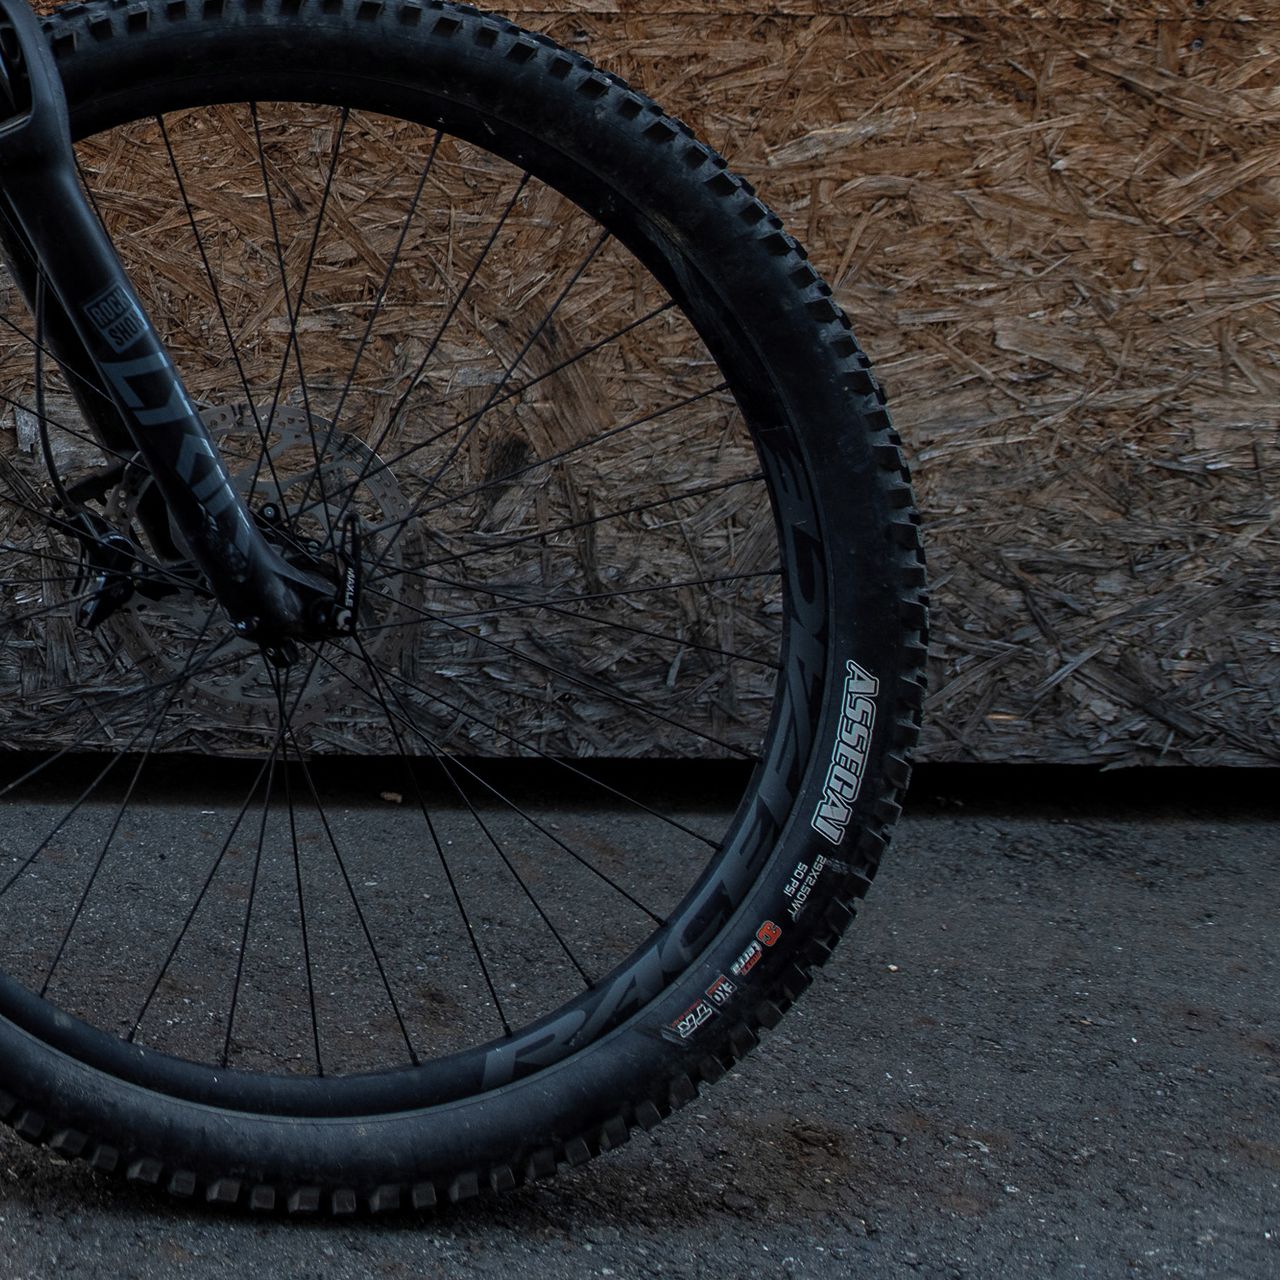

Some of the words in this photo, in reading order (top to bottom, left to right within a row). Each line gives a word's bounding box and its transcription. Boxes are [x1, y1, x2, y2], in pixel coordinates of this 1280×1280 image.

[90, 287, 136, 328] ROCK
[812, 660, 880, 846] ASSEGAI
[793, 862, 808, 880] 50
[784, 878, 800, 897] PSI
[711, 981, 733, 1002] EXO
[677, 1003, 712, 1038] TR
